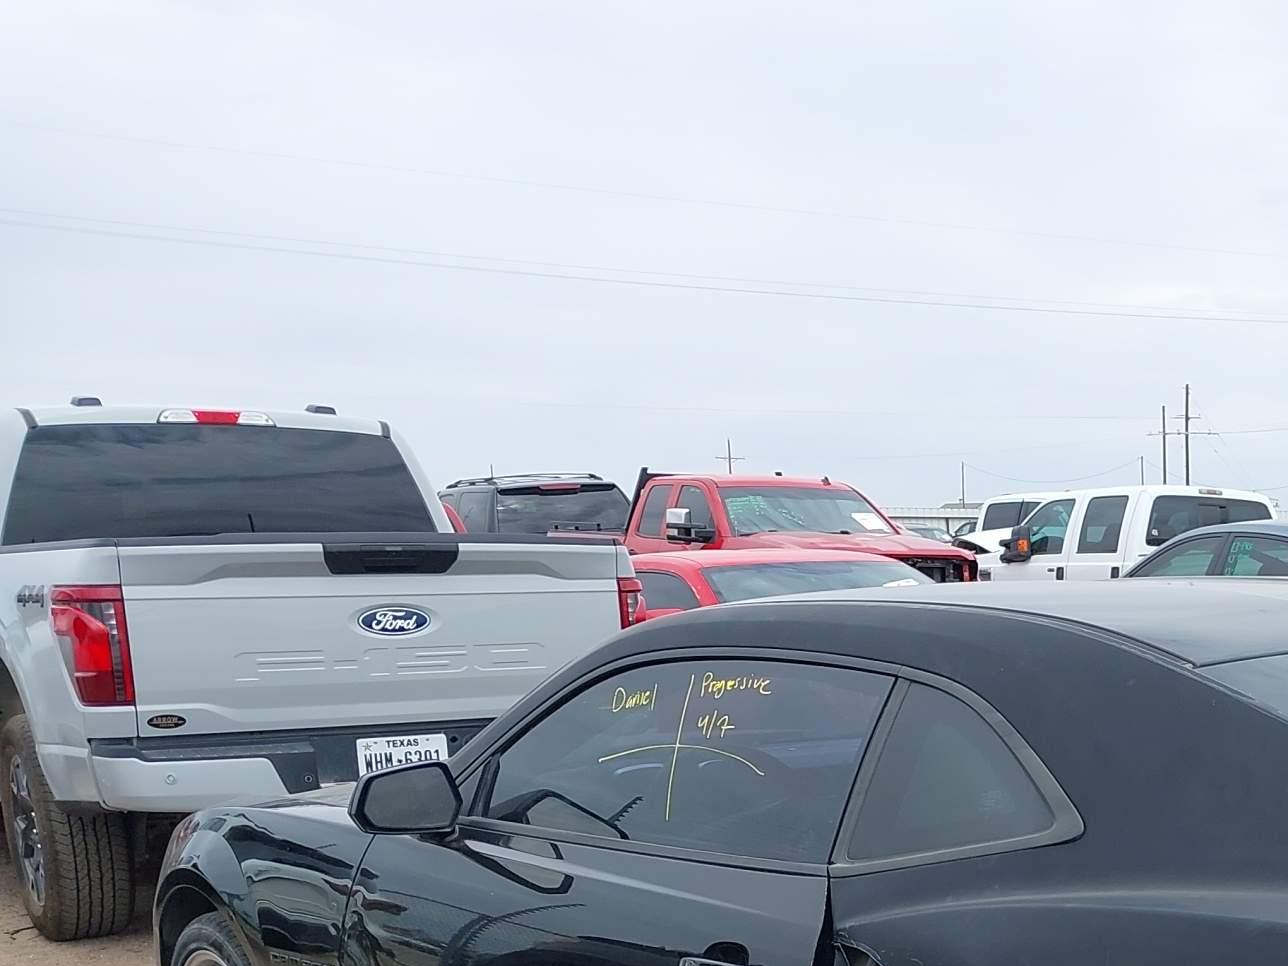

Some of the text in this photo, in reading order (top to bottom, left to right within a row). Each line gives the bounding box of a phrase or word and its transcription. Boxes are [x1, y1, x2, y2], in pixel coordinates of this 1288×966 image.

[371, 611, 417, 630] Ford
[612, 683, 658, 713] Daniel
[698, 710, 736, 738] 4/7
[385, 738, 419, 749] TEXAS
